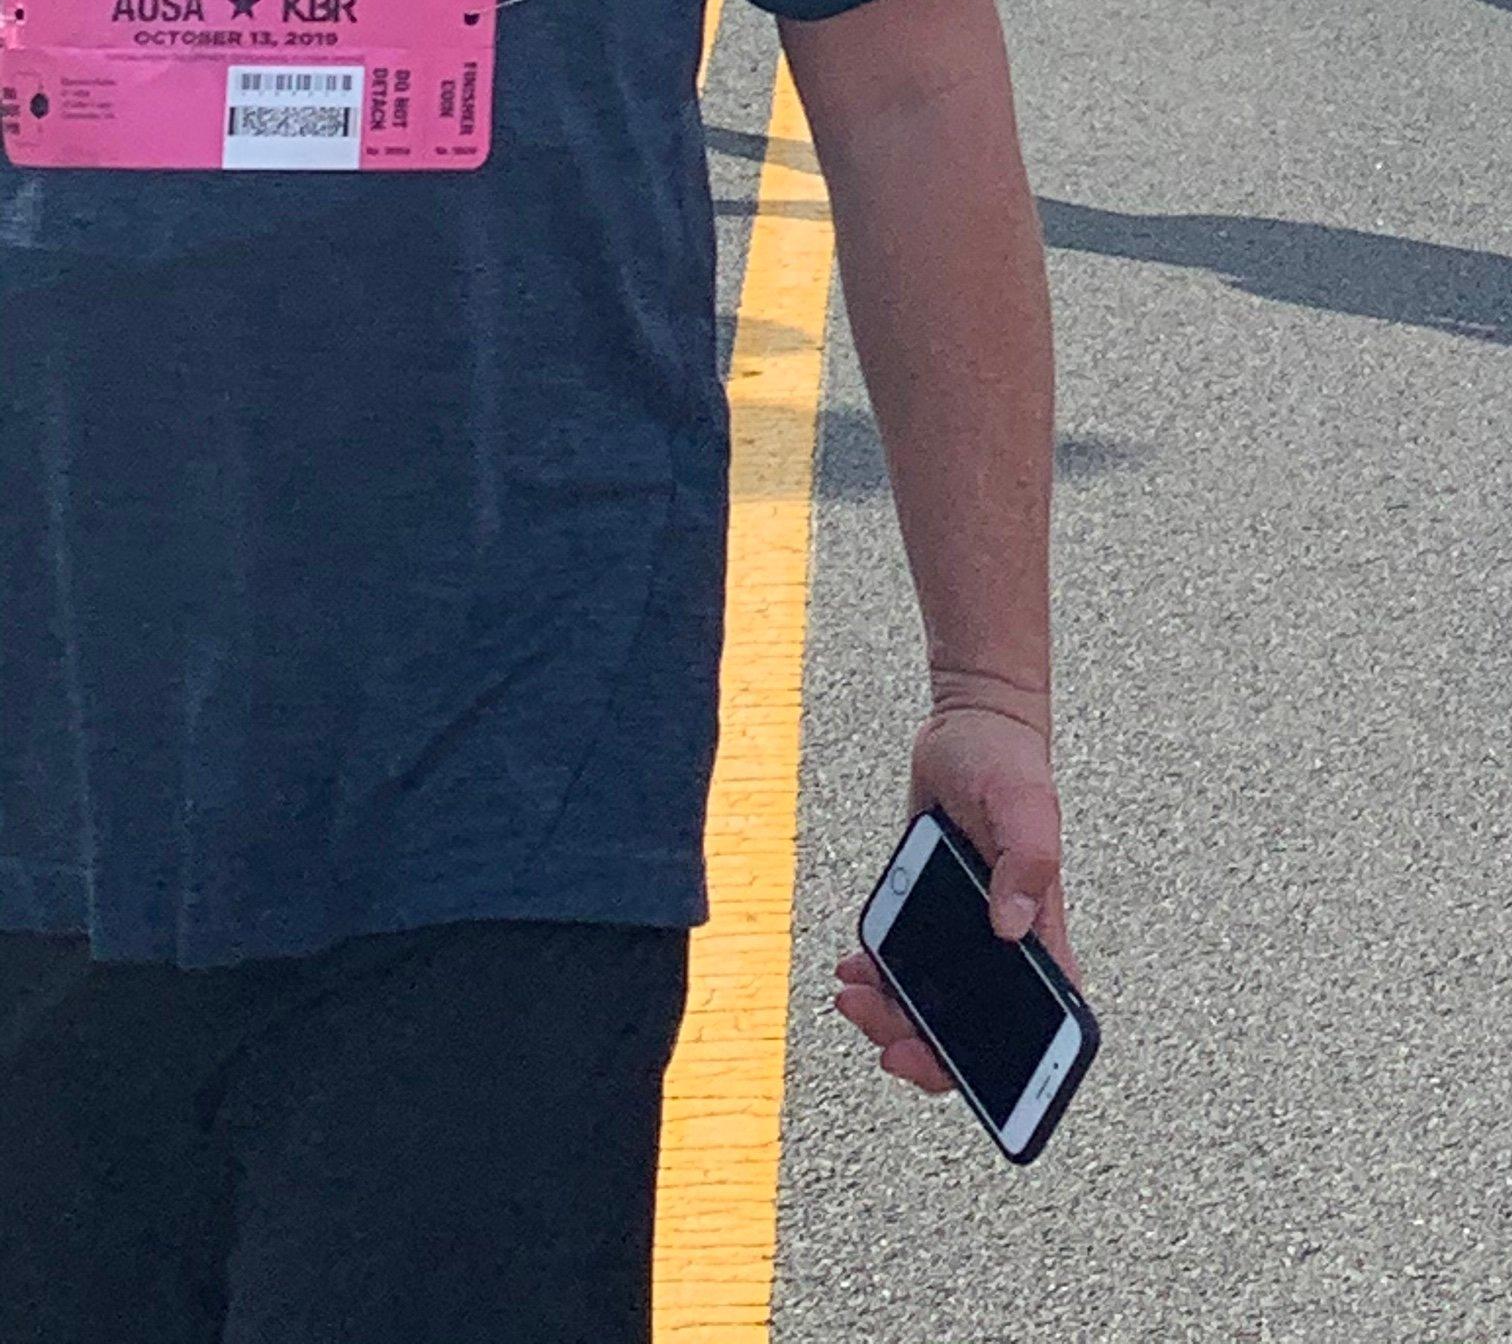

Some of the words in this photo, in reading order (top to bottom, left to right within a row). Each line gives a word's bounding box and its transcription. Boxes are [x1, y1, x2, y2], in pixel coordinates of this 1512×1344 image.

[133, 30, 243, 47] OCTOBER
[248, 30, 279, 48] 13,
[284, 30, 338, 46] 2019
